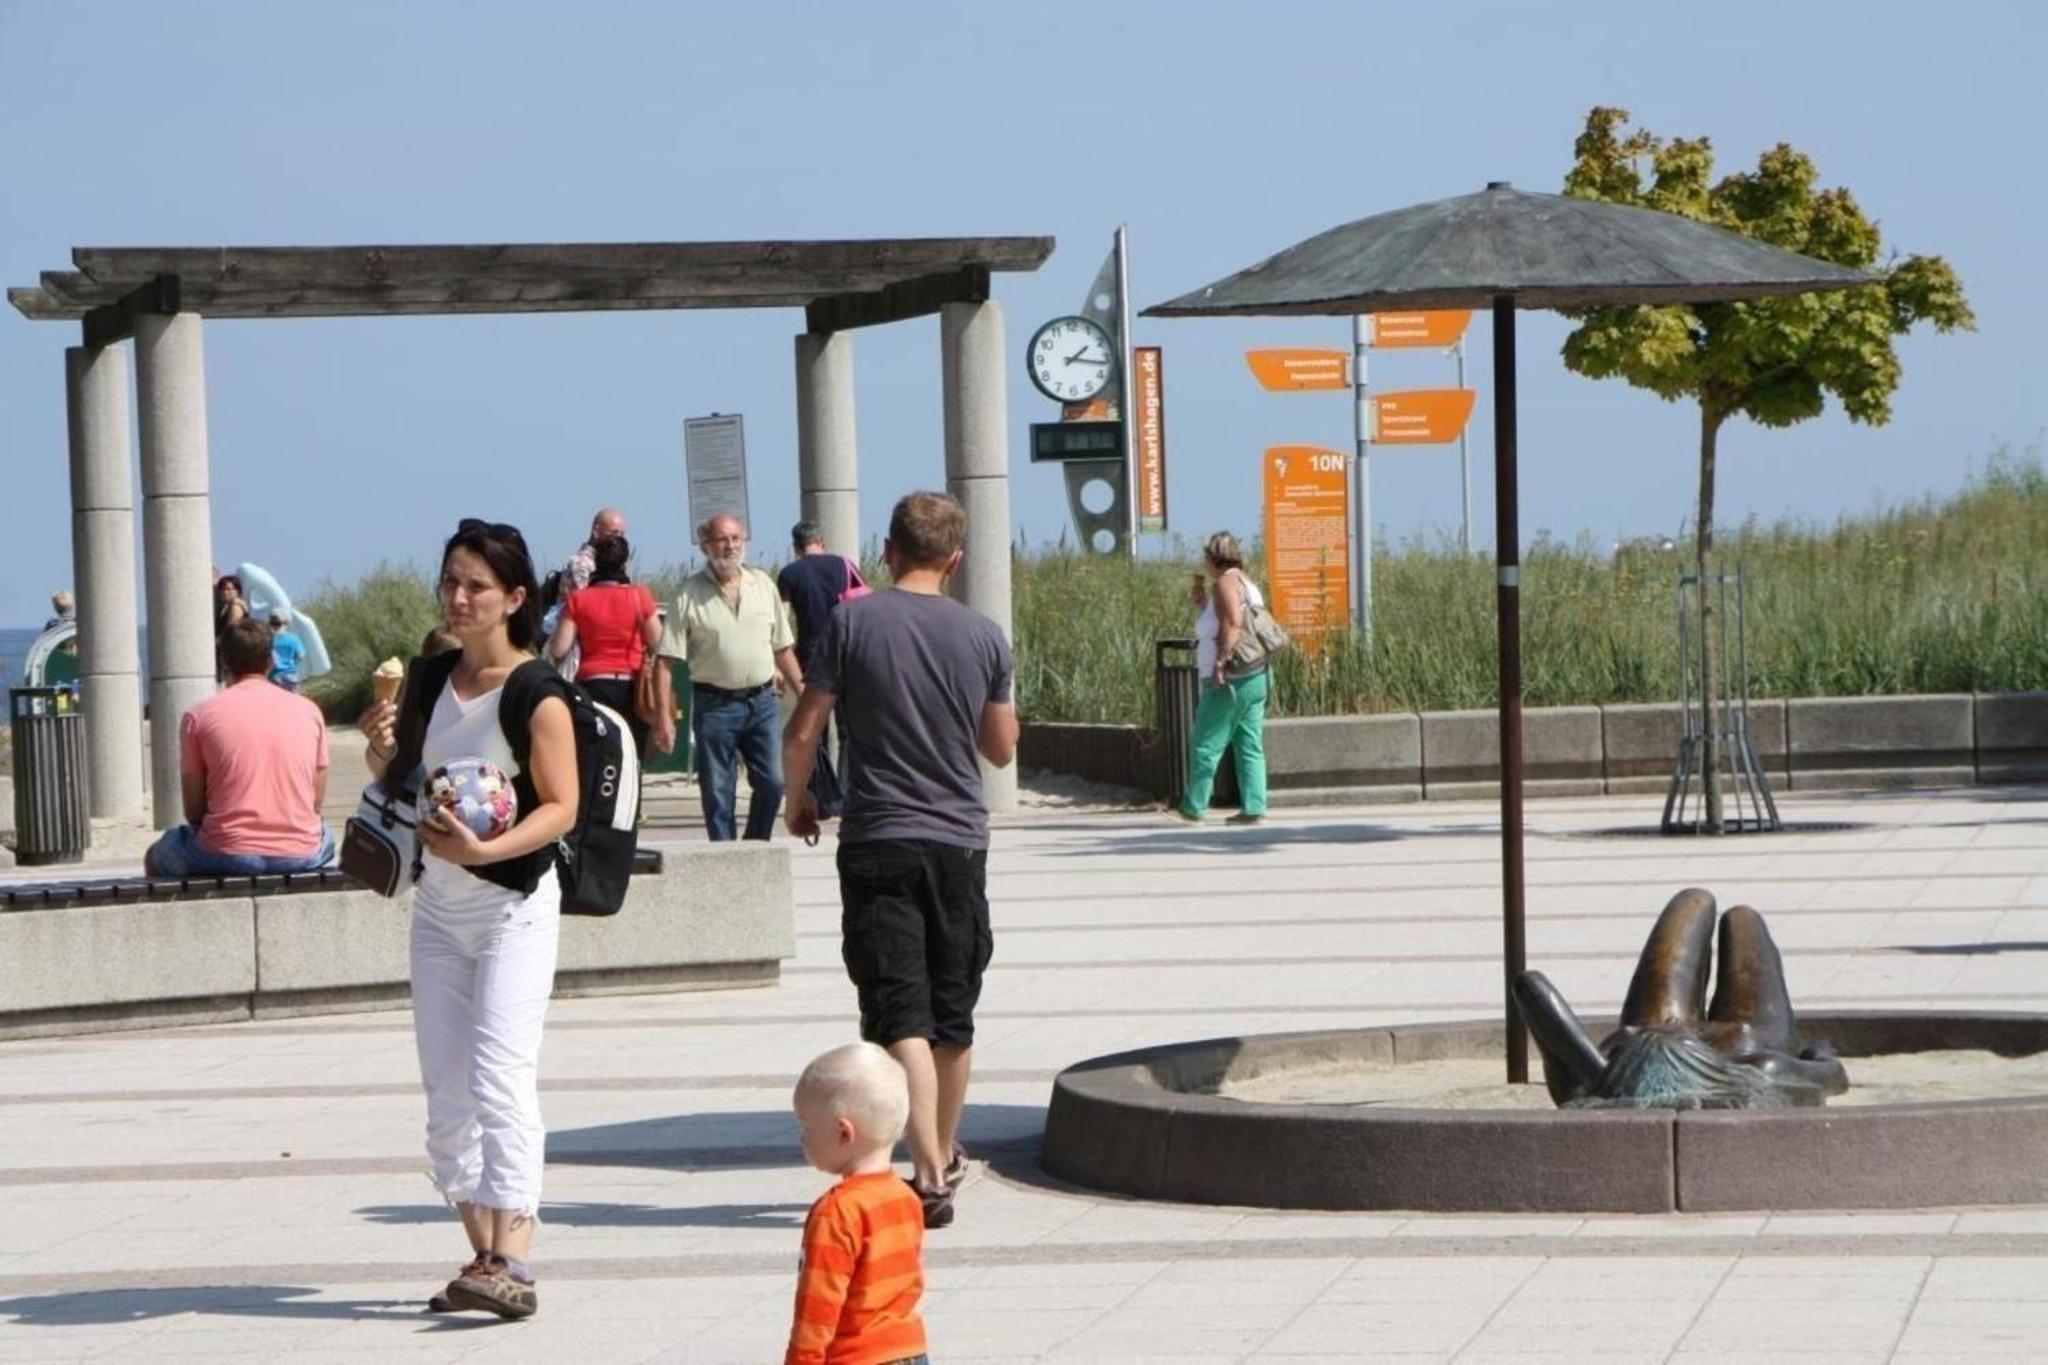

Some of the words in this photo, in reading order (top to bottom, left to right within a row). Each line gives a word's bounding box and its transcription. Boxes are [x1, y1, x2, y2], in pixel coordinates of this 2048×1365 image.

[1051, 326, 1062, 338] 11
[1065, 320, 1079, 332] 12
[1085, 325, 1092, 336] 1
[1040, 339, 1054, 351] 10
[1096, 336, 1105, 348] 2
[1036, 354, 1045, 366] 9
[1041, 370, 1050, 381] 8
[1096, 369, 1104, 379] 4
[1055, 381, 1063, 393] 7
[1069, 385, 1078, 397] 6
[1084, 380, 1094, 393] 5
[1142, 352, 1161, 515] www.karlshagen.de
[1308, 454, 1345, 472] 10N
